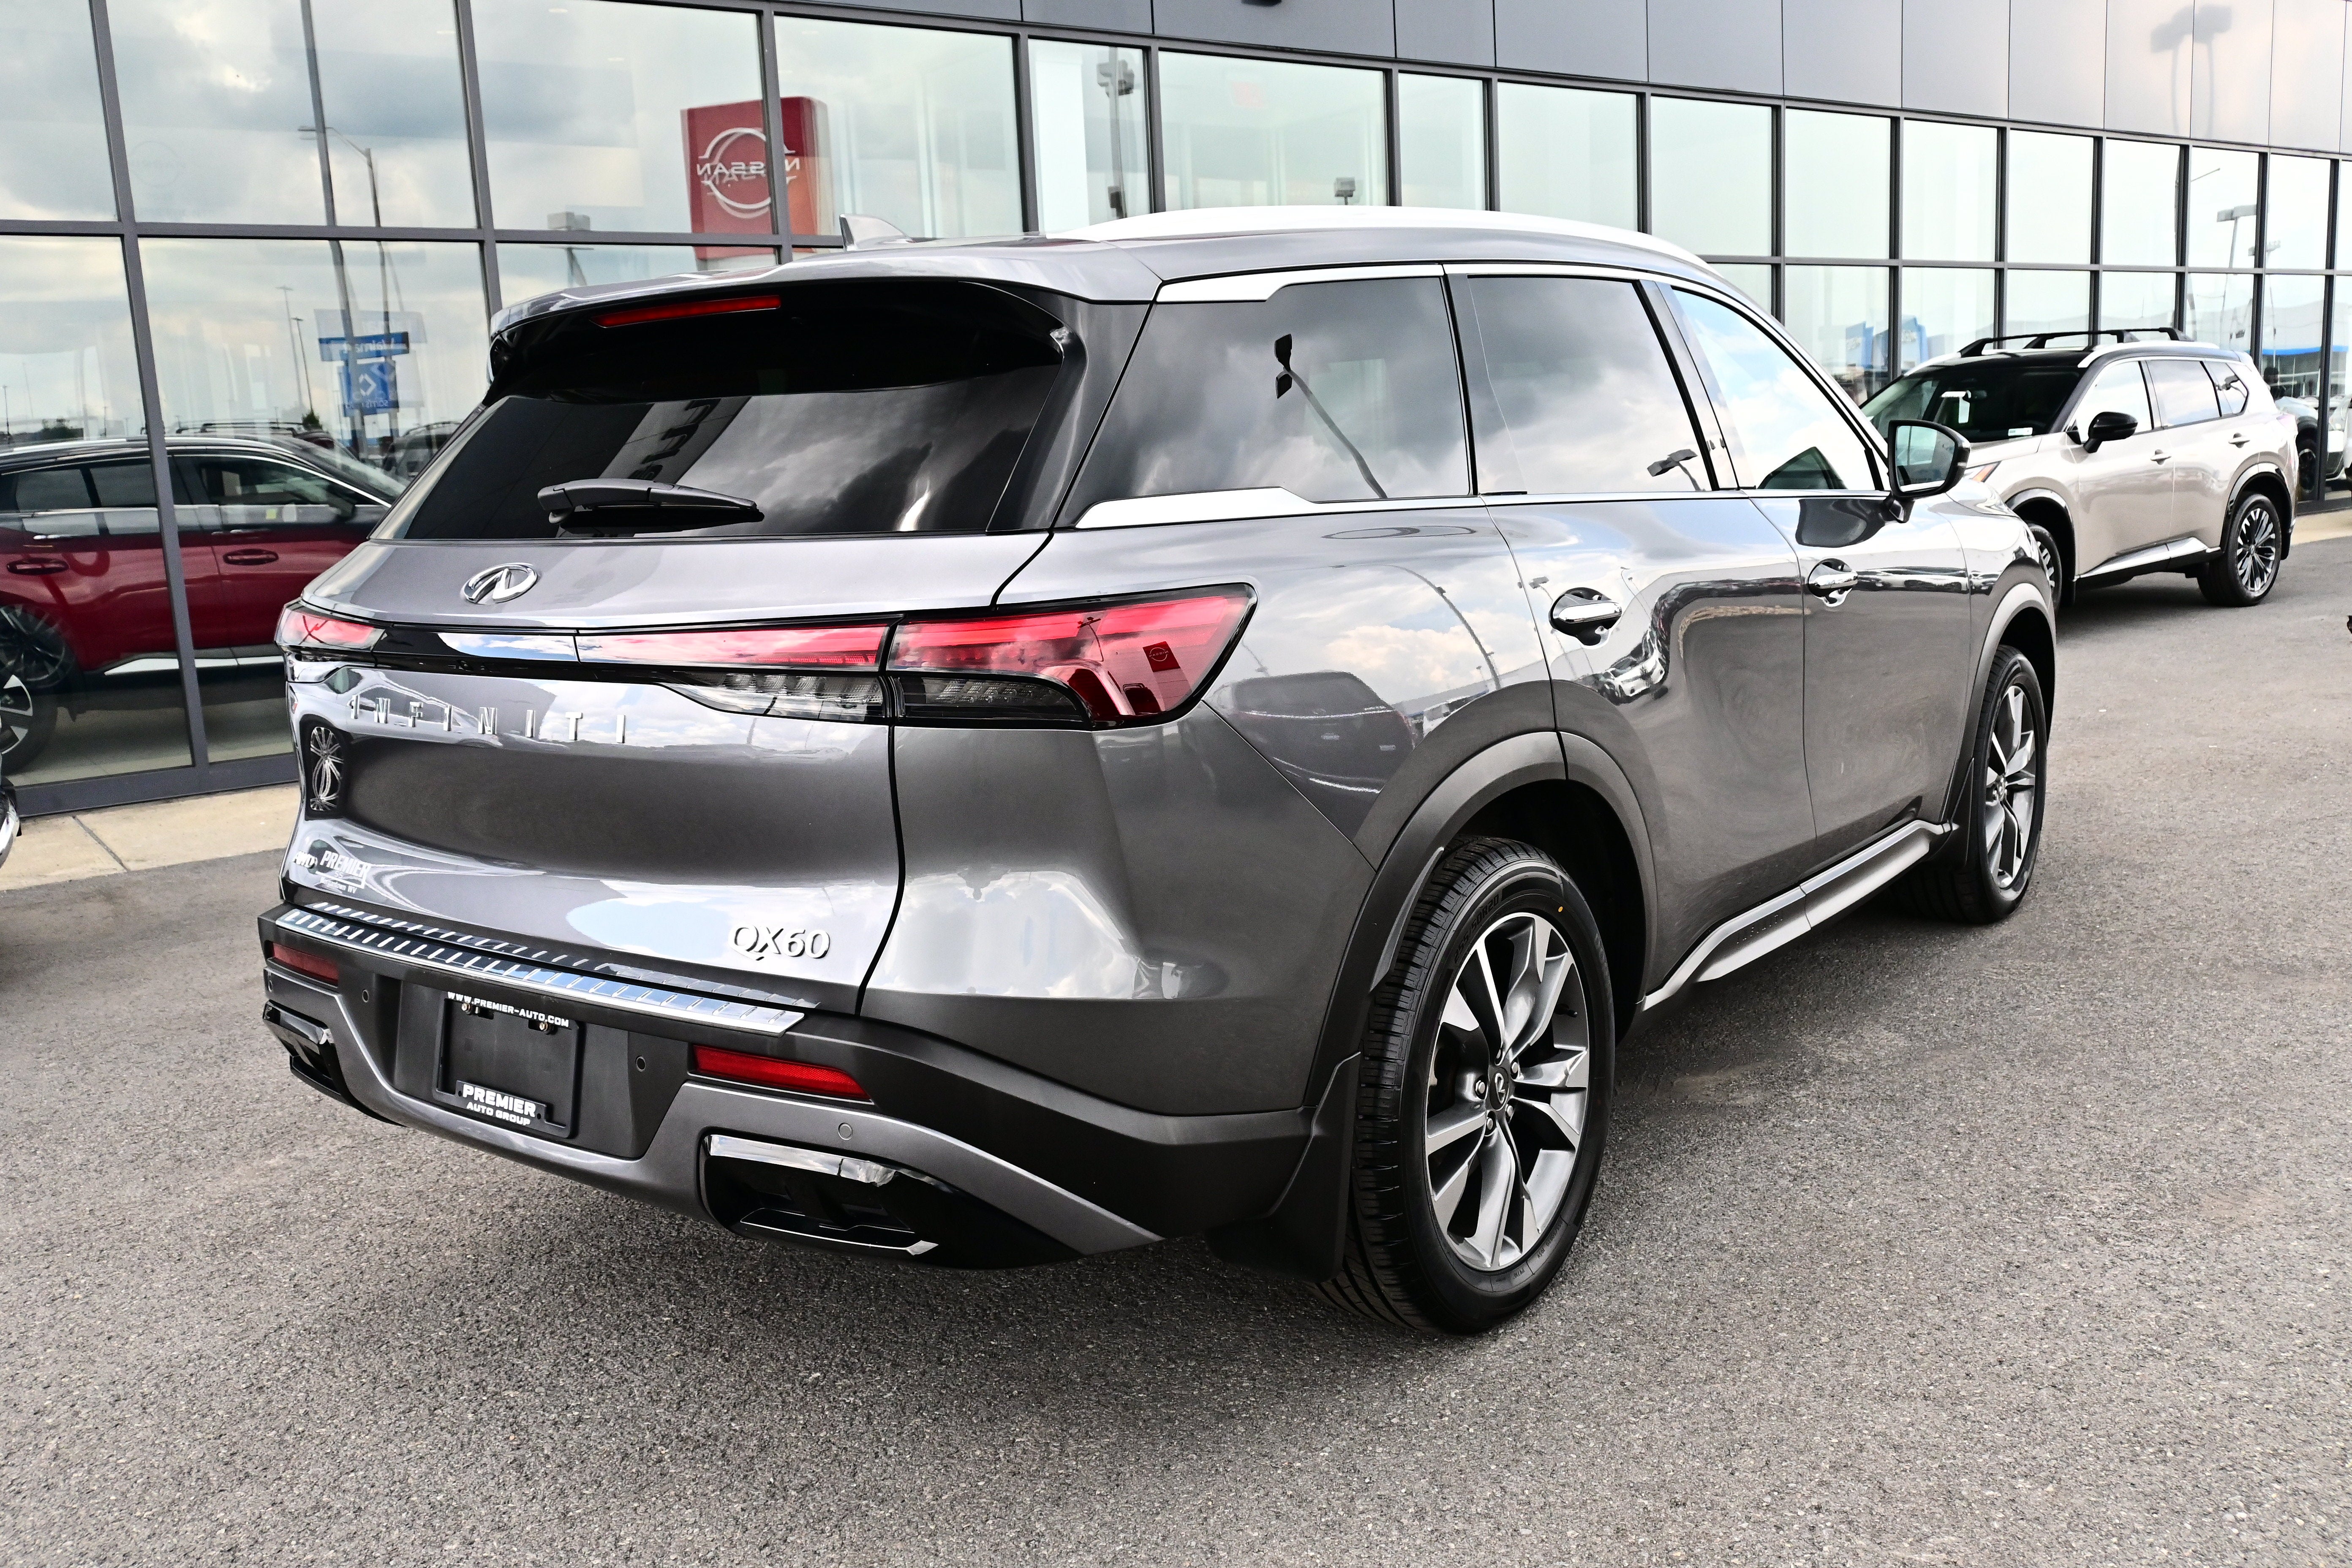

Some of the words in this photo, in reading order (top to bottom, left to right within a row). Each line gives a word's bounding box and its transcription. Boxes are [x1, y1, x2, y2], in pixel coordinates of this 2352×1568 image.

[351, 694, 626, 743] INFINITI
[292, 851, 317, 869] AWD
[319, 850, 371, 878] PREMIER
[347, 885, 357, 894] WV
[727, 924, 830, 961] QX60
[447, 991, 569, 1028] WWW.PREMIER-AUTO.COM
[462, 1083, 536, 1118] PREMIER
[466, 1101, 494, 1116] AUTO
[495, 1110, 531, 1126] GROUP
